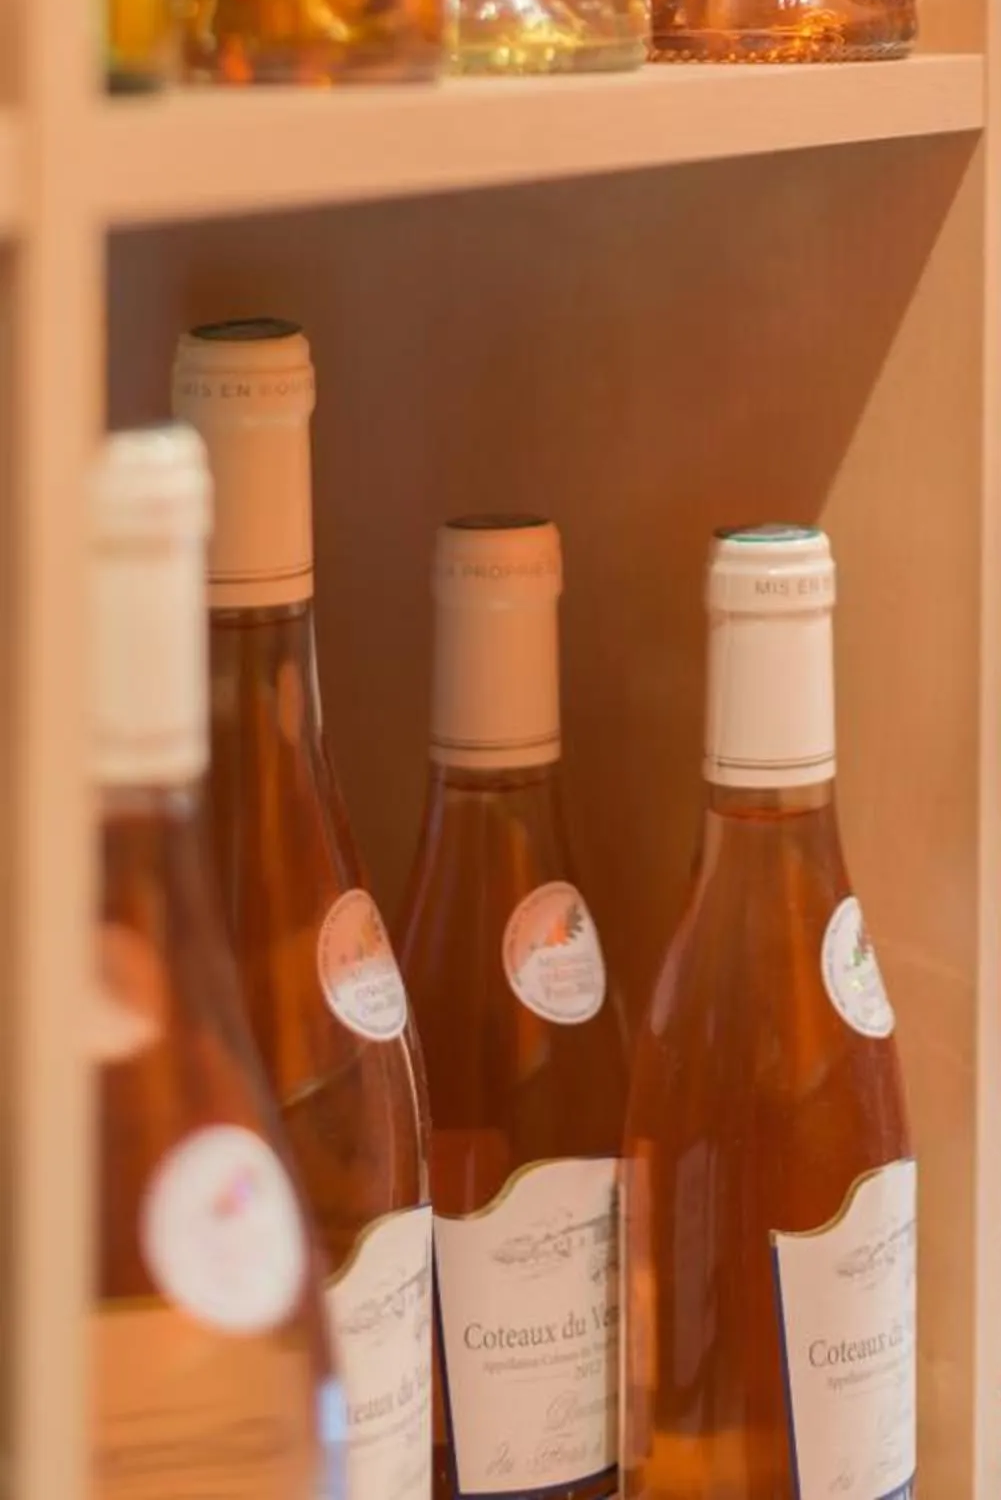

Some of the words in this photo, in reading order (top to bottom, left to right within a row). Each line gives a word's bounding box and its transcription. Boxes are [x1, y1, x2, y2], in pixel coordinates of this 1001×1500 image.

[220, 383, 251, 398] EN
[755, 579, 789, 596] MIS
[463, 1322, 557, 1350] Coteaux
[562, 1310, 587, 1340] du
[808, 1332, 889, 1368] Coteaux
